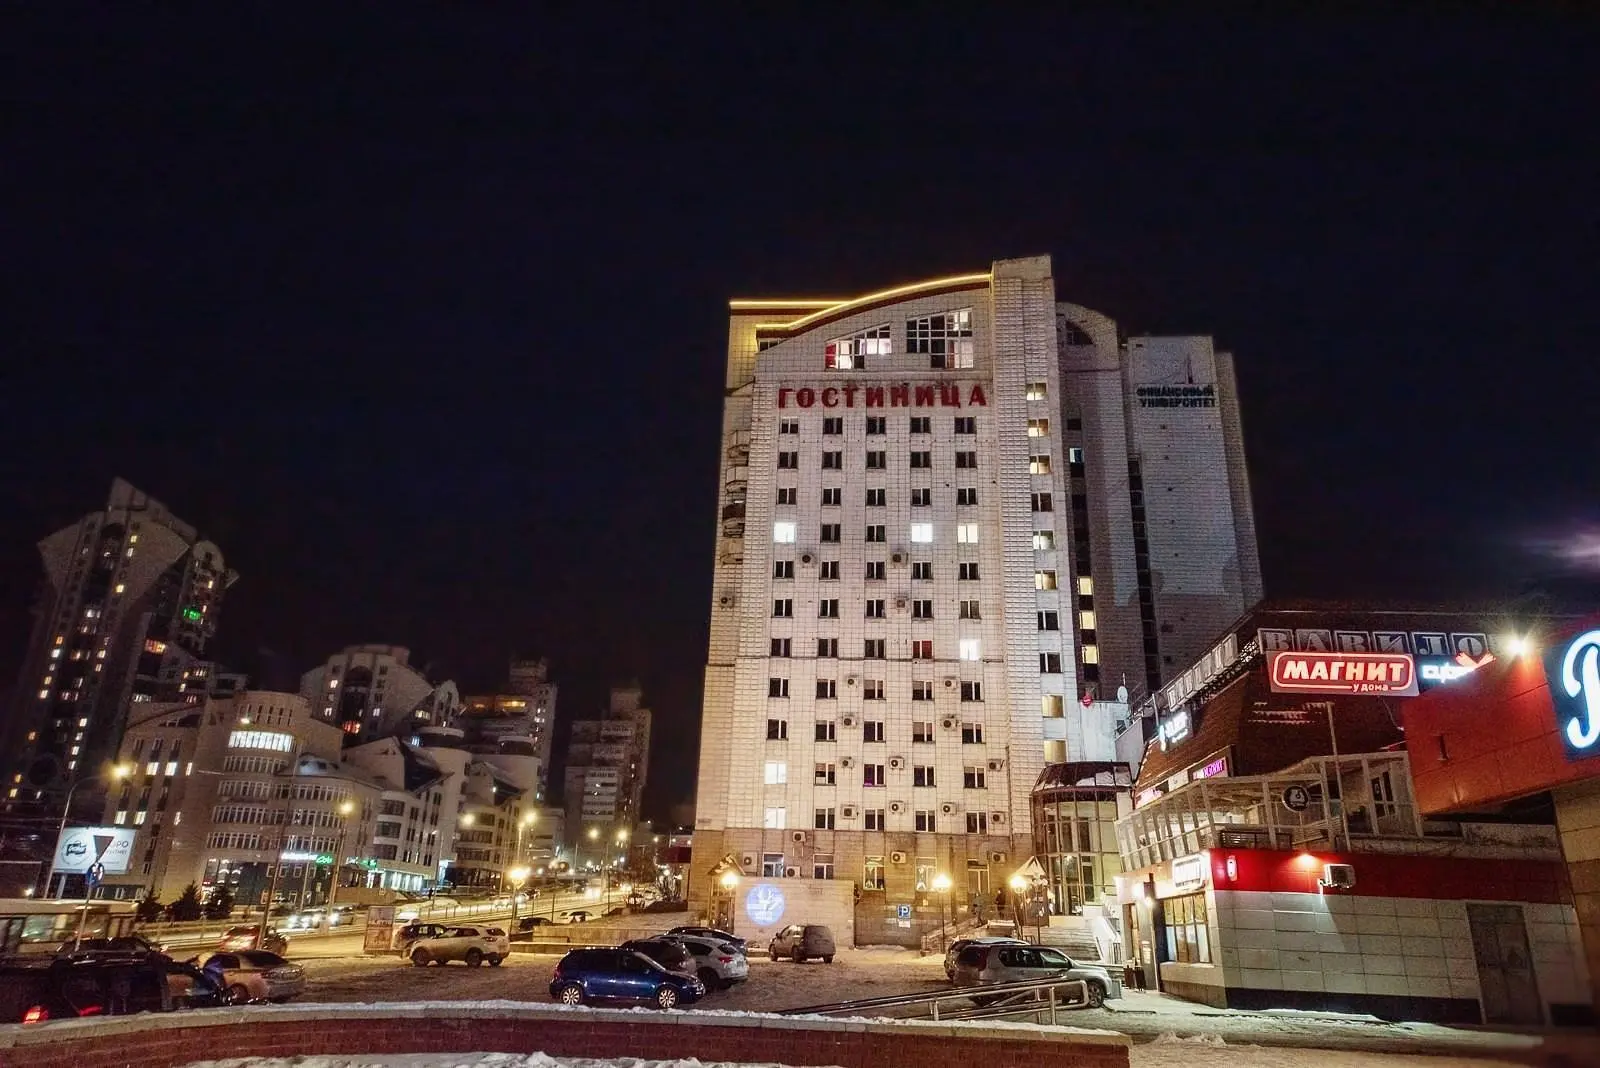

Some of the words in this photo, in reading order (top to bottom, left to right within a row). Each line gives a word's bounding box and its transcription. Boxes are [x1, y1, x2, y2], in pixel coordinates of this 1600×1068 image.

[778, 384, 987, 409] ГОСТИНИЦА
[1282, 660, 1404, 682] МАГНИТ
[1352, 684, 1361, 693] у
[1362, 683, 1389, 692] дома
